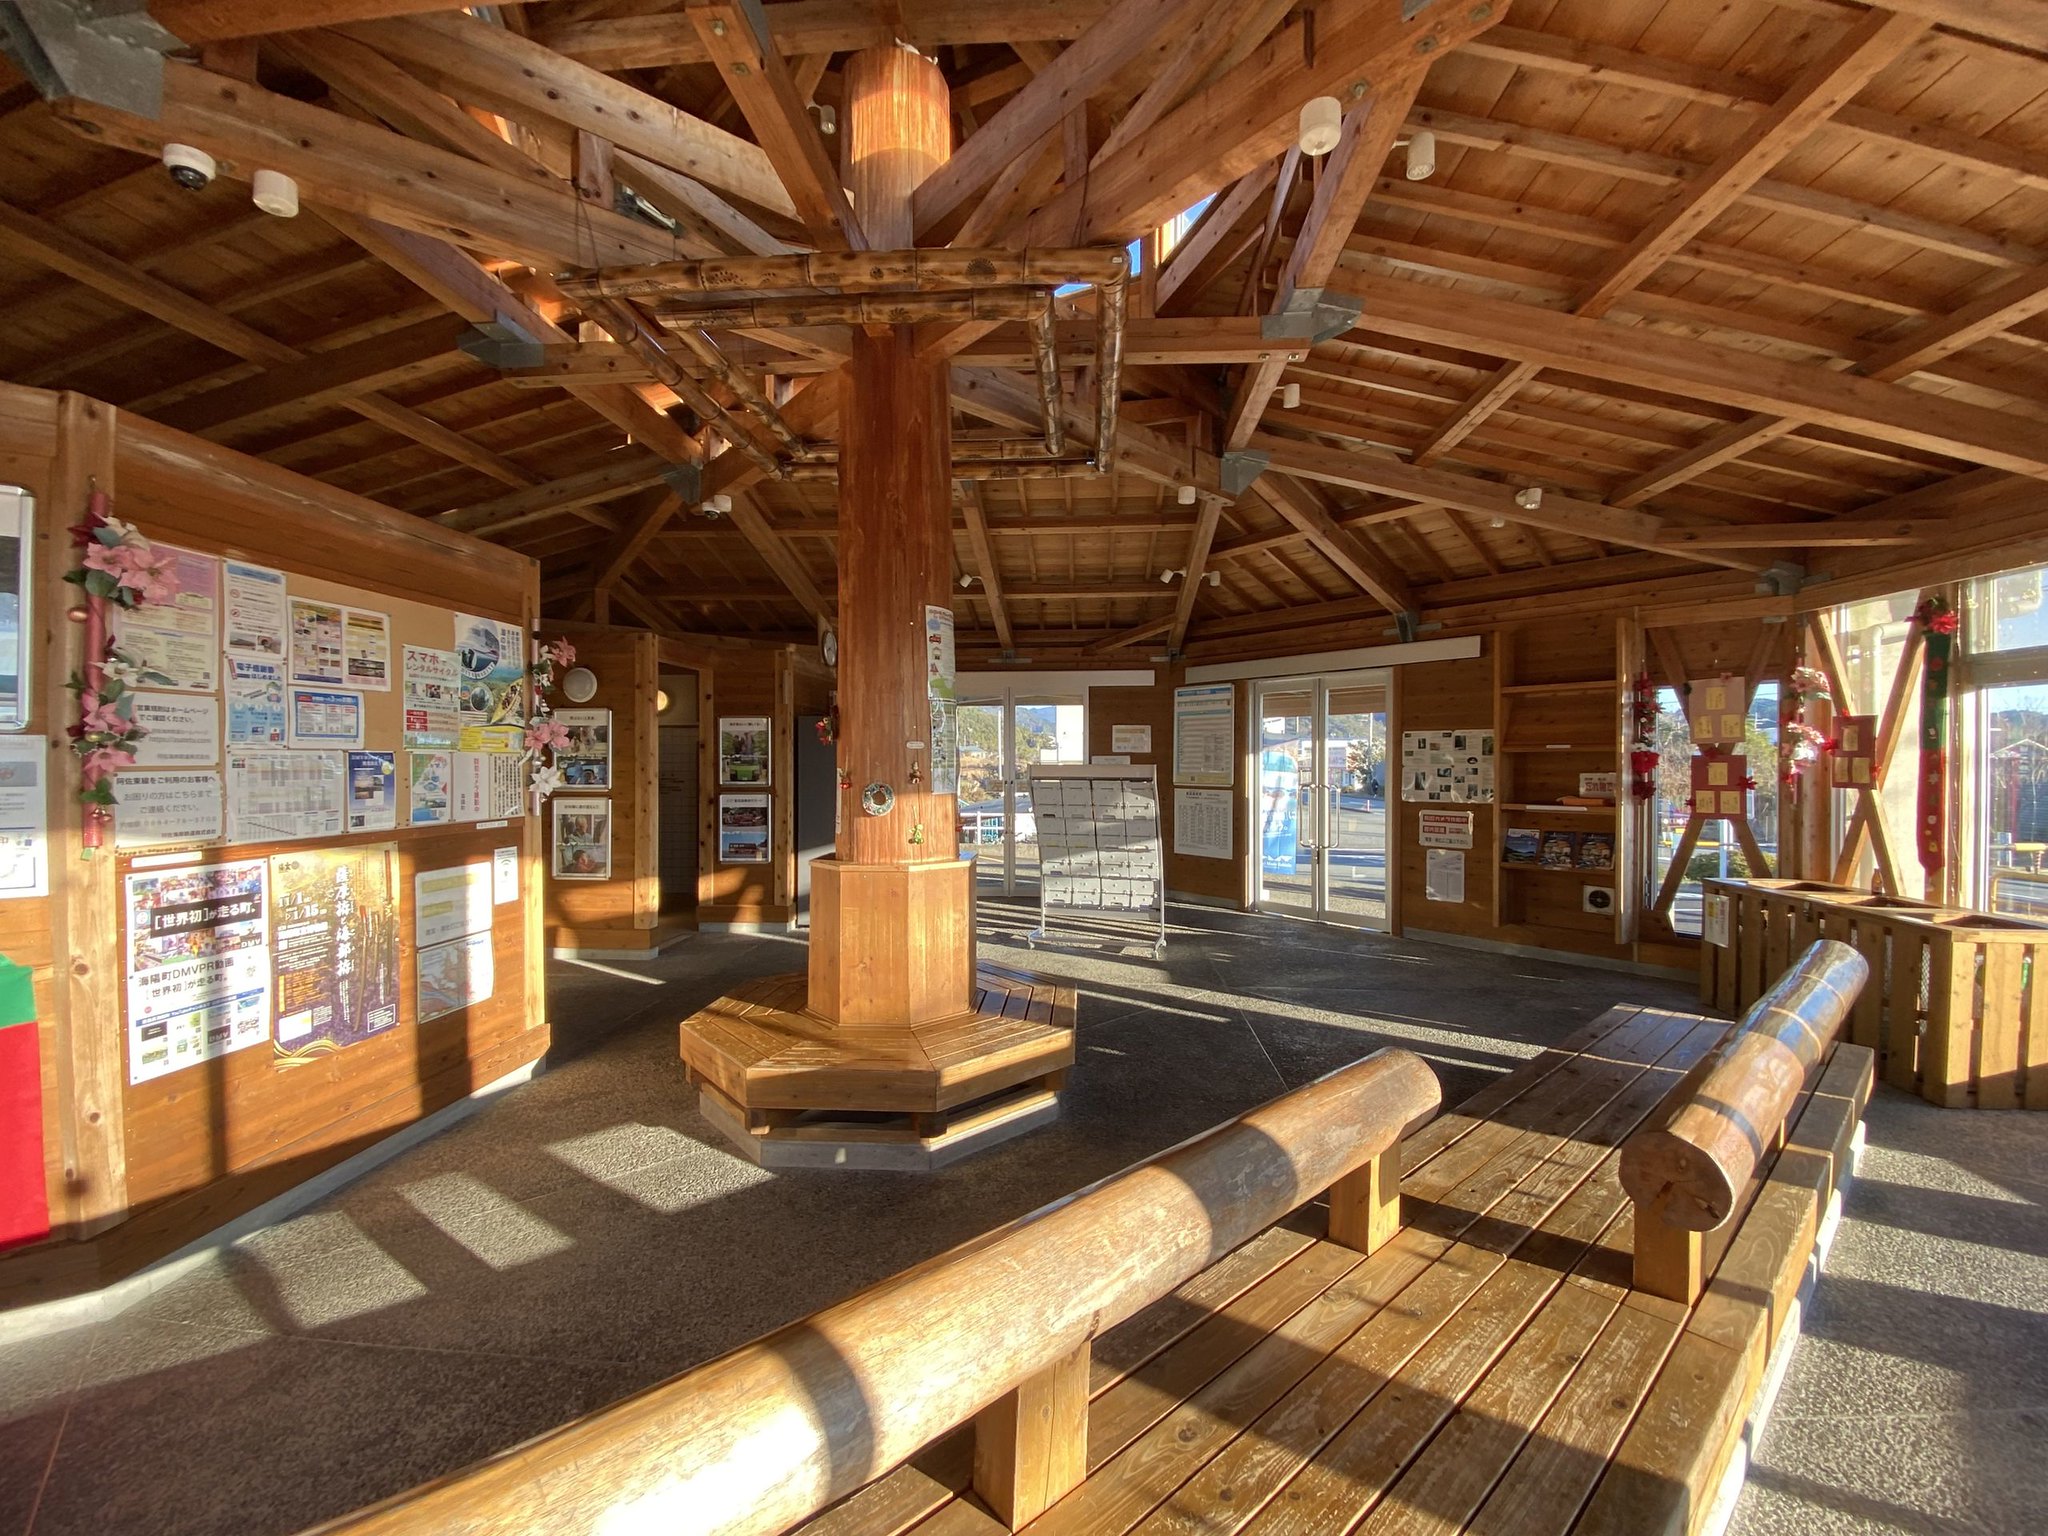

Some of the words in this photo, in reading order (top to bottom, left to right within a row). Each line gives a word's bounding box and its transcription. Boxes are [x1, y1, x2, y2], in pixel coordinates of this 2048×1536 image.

[116, 776, 216, 785] 阿佐東線をご利用のお客様へ
[124, 790, 213, 800] お困りの方はこちらまで
[140, 804, 199, 814] ご連絡ください。
[154, 901, 256, 930] [世界初]が走る町。
[240, 938, 261, 948] DMV
[138, 957, 235, 987] 海陽町DMVPR動画
[209, 1031, 229, 1044] DMV
